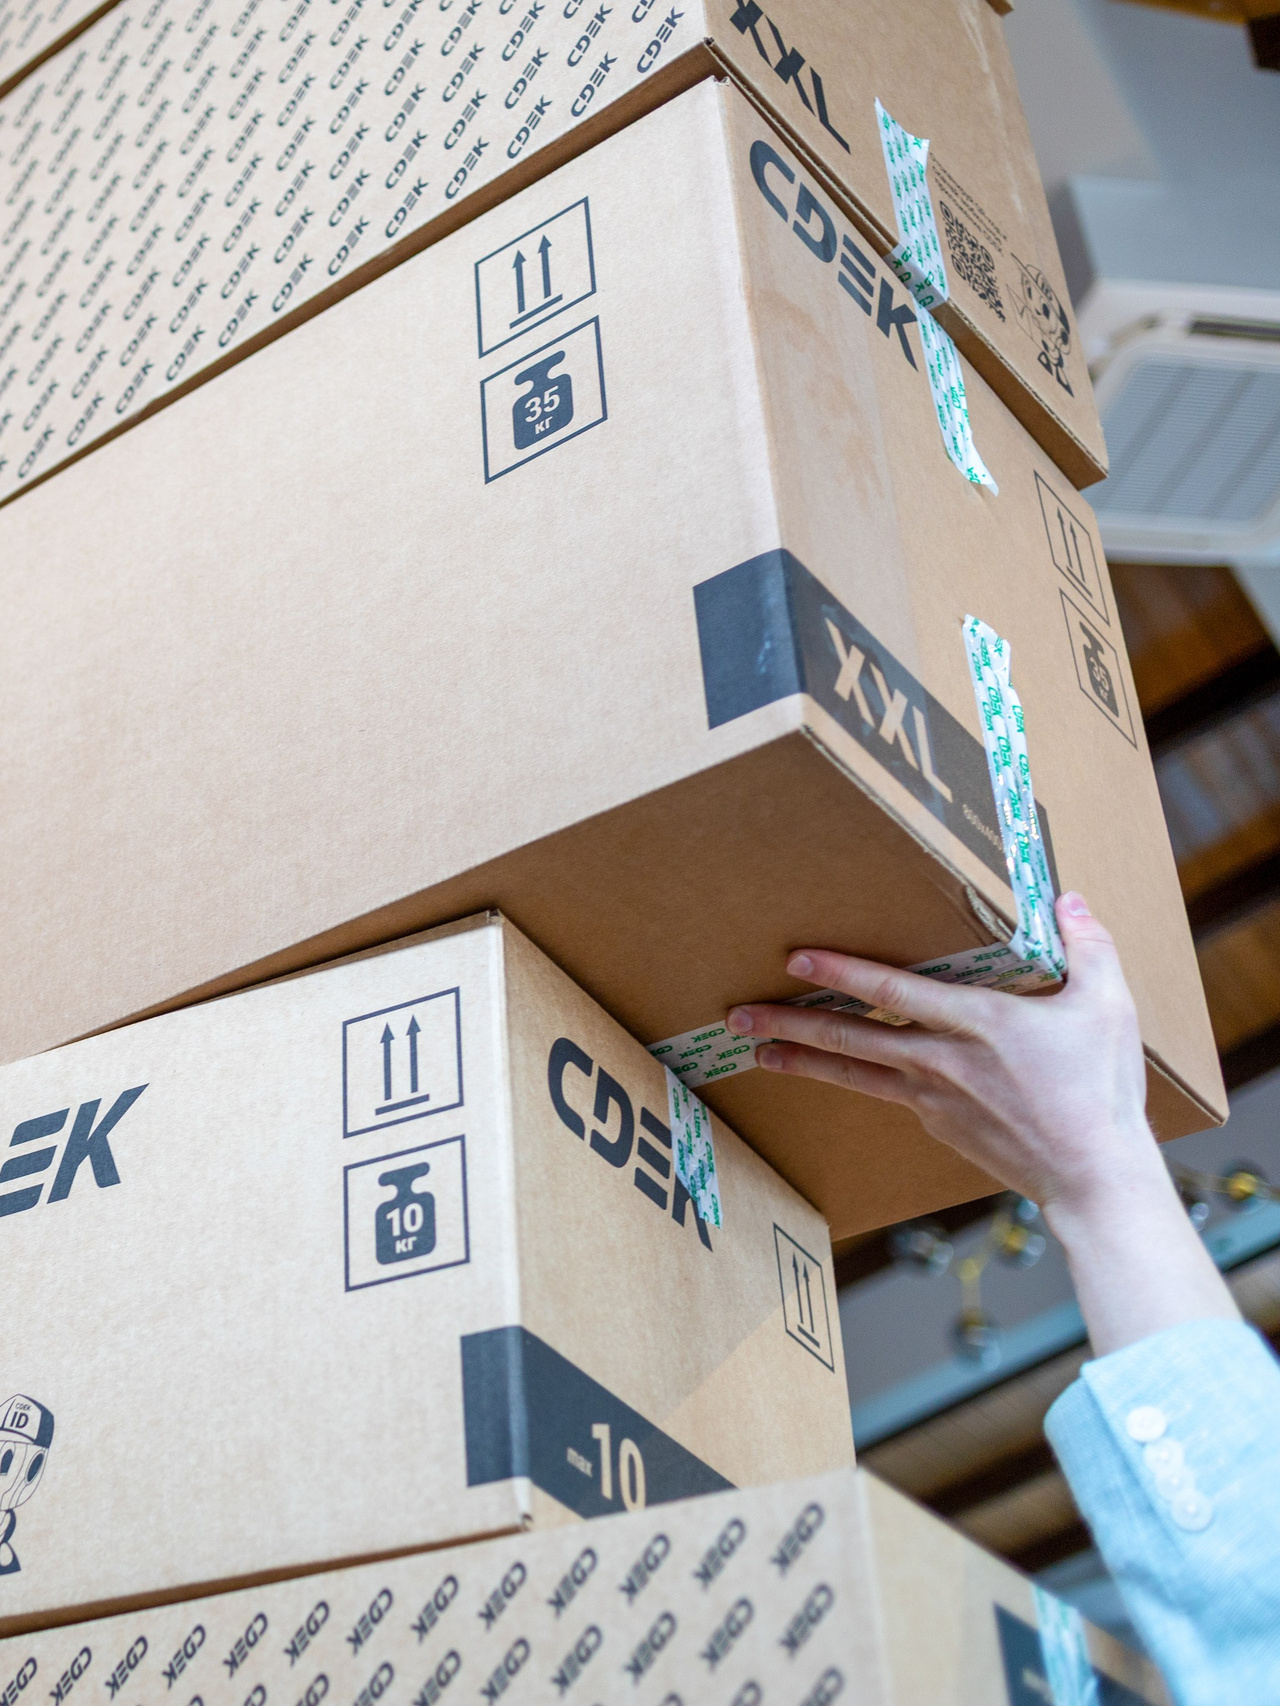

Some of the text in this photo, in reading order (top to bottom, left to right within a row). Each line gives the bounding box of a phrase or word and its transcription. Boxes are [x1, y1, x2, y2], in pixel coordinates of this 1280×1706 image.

[329, 0, 367, 47] CDEK
[383, 0, 425, 51] CDEK
[440, 0, 484, 57] CDEK
[501, 3, 546, 61] CDEK
[567, 4, 613, 67] CDEK
[637, 6, 685, 73] CDEK
[329, 35, 370, 90] CDEK
[384, 39, 425, 96] CDEK
[442, 43, 485, 102] CDEK
[504, 47, 550, 109] CDEK
[570, 51, 618, 117] CDEK
[730, 0, 851, 155] XXL
[329, 78, 370, 135] CDEK
[384, 83, 427, 142] CDEK
[444, 89, 488, 150] CDEK
[506, 95, 553, 159] CDEK
[329, 123, 370, 180] CDEK
[385, 130, 428, 189] CDEK
[444, 136, 490, 199] CDEK
[275, 161, 316, 217] CDEK
[328, 169, 371, 227] CDEK
[385, 177, 429, 238] CDEK
[273, 207, 315, 264] CDEK
[327, 216, 370, 276] CDEK
[749, 139, 919, 372] CDEK
[220, 243, 261, 300] CDEK
[271, 253, 314, 312] CDEK
[218, 290, 260, 347] CDEK
[165, 325, 206, 381] CDEK
[116, 359, 154, 414] CDEK
[525, 385, 560, 422] 35
[1089, 656, 1110, 692] 35
[825, 618, 953, 803] XXL
[973, 947, 1011, 963] CDEK
[649, 1045, 673, 1057] CDE
[677, 1044, 712, 1060] CDEK
[691, 1027, 726, 1043] CDEK
[715, 1044, 751, 1061] CDEK
[671, 1062, 698, 1075] CDE
[703, 1062, 738, 1079] CDEK
[386, 1203, 424, 1236] 10
[10, 1411, 29, 1429] ID
[591, 1422, 646, 1513] 10
[346, 1587, 394, 1656] CDEK
[410, 1574, 459, 1643] CDEK
[478, 1561, 527, 1631] CDEK
[161, 1624, 206, 1690] CDEK
[222, 1612, 268, 1679] CDEK
[283, 1600, 330, 1667] CDEK
[49, 1646, 92, 1706] CDEK
[104, 1635, 148, 1701] CDEK
[354, 1662, 394, 1706] CDE
[480, 1637, 531, 1706] CDEK
